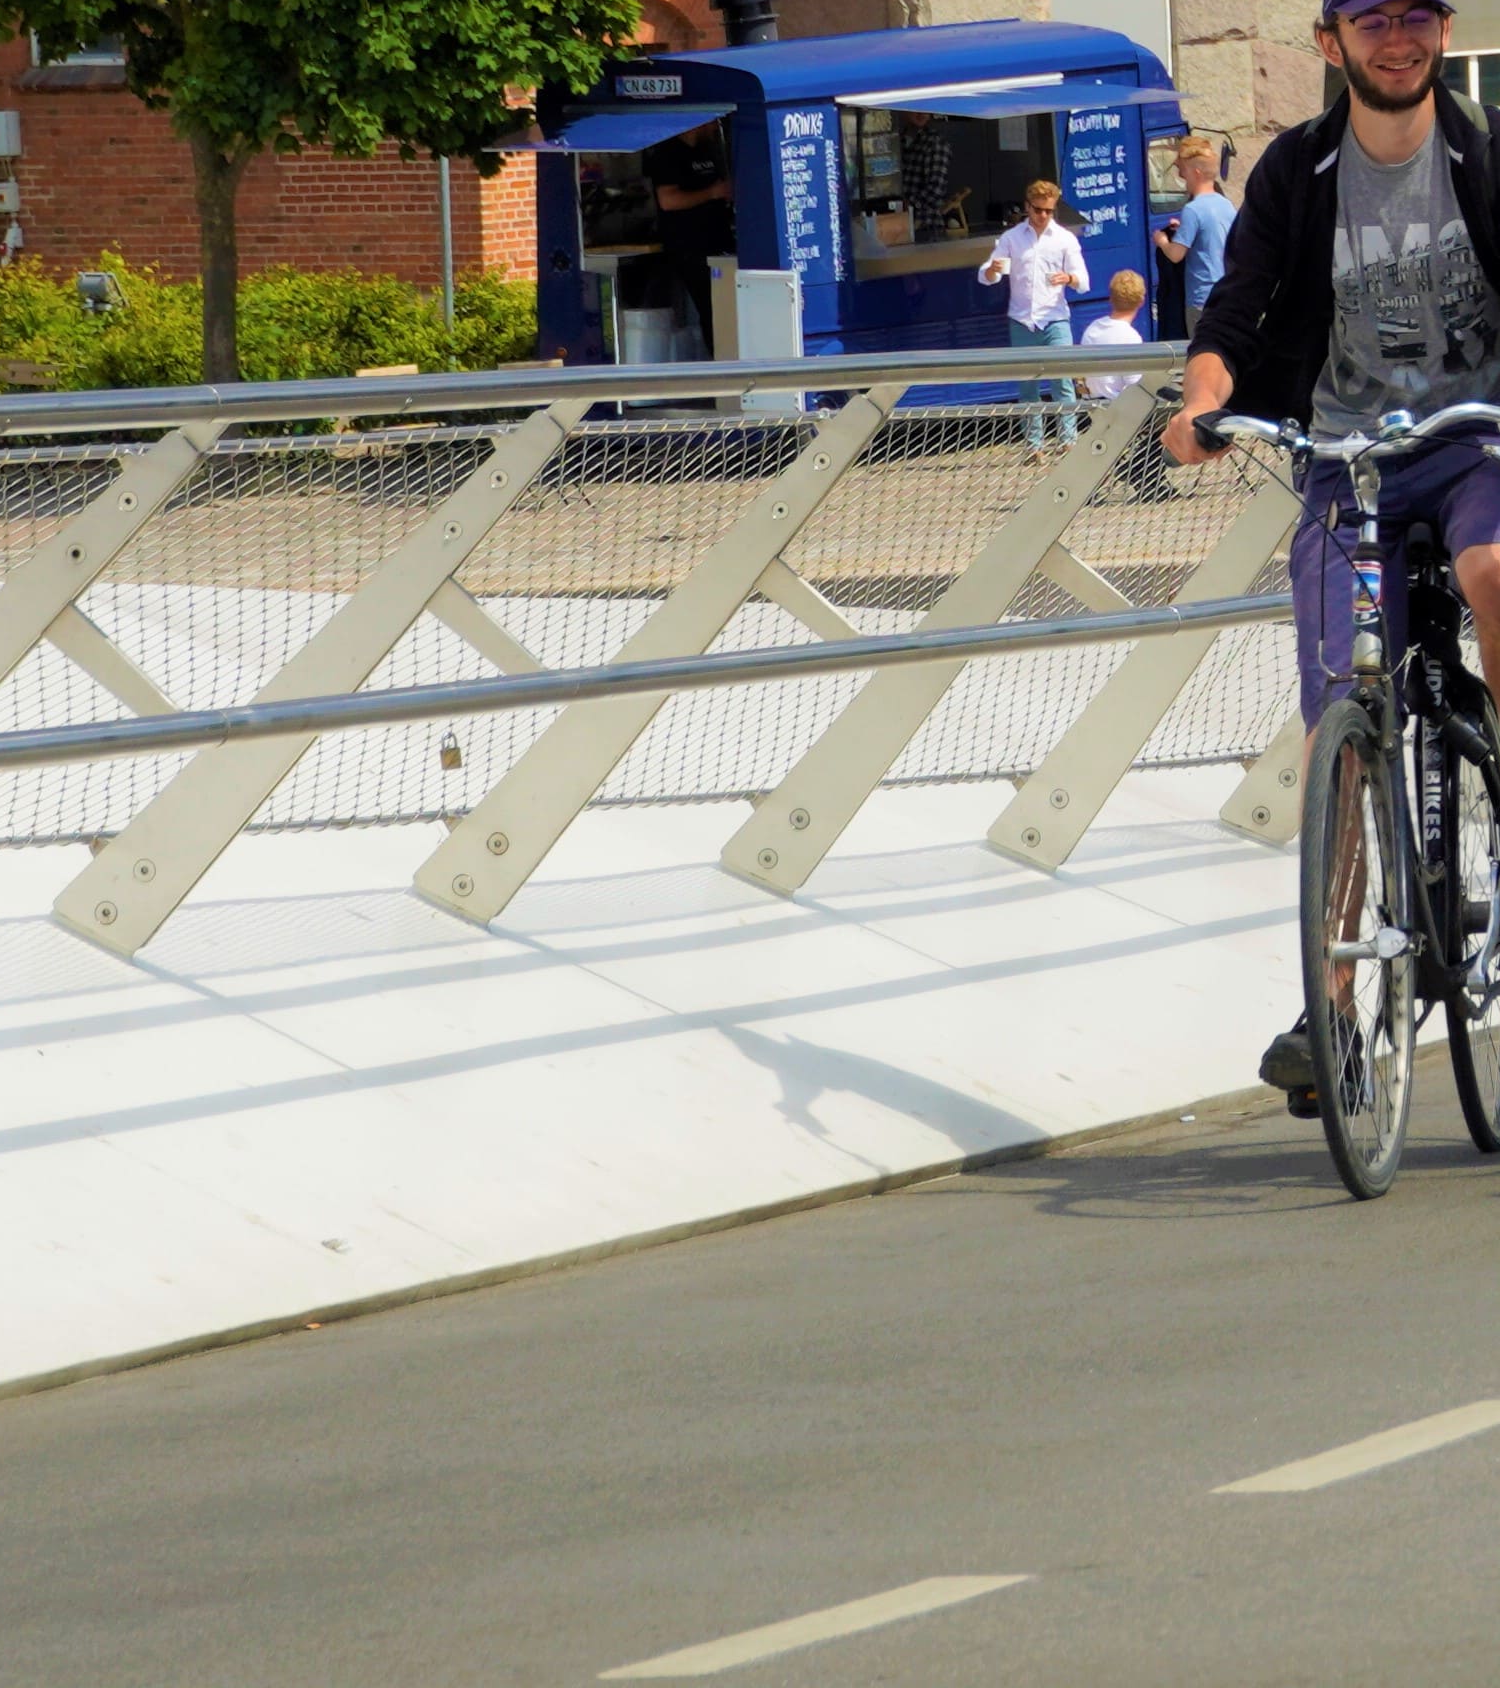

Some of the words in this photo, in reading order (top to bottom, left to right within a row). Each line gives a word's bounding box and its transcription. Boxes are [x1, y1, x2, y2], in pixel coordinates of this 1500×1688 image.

[624, 79, 639, 93] CN
[642, 79, 657, 93] 48
[658, 79, 678, 93] 731
[1425, 769, 1442, 841] BIKES
